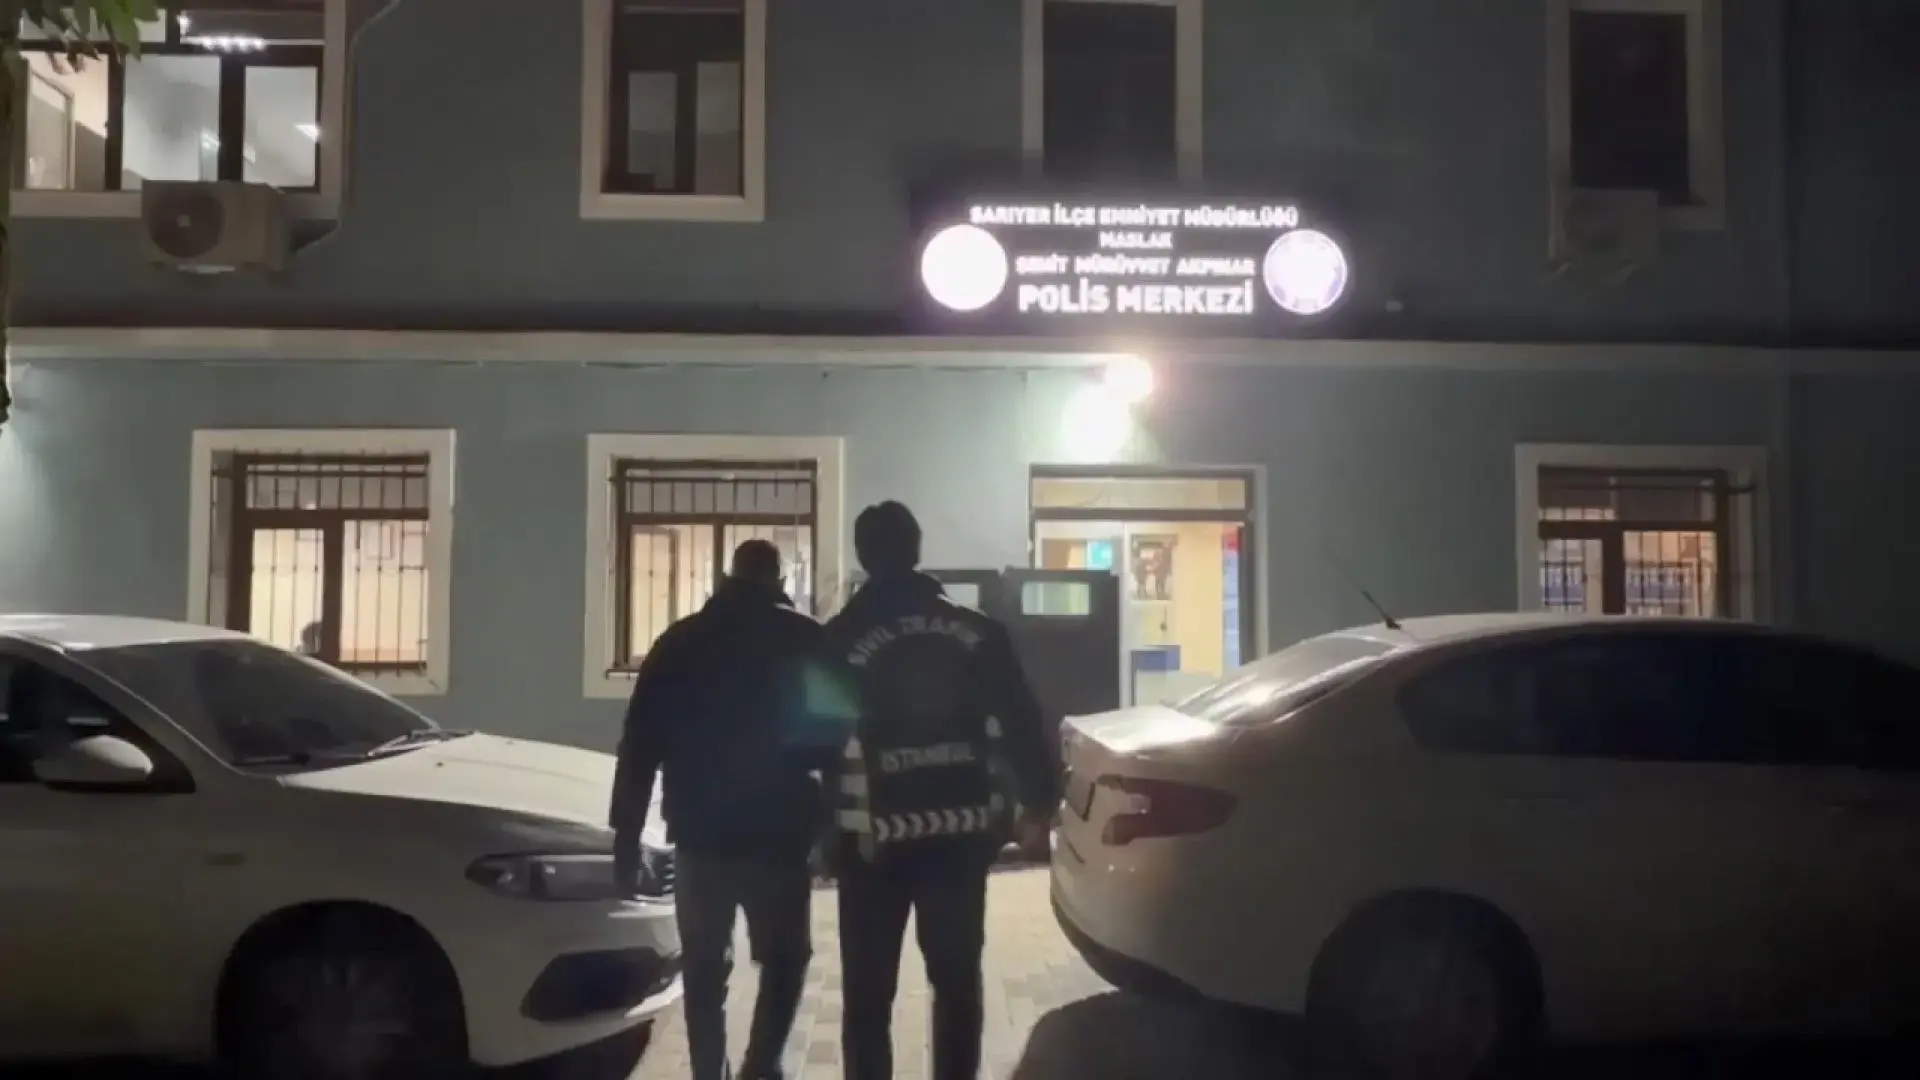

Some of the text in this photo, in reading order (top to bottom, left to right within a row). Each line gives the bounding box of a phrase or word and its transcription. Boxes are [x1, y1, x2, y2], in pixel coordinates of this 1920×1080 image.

[969, 205, 1051, 226] SARIYER
[1054, 202, 1096, 228] İLÇE
[1018, 278, 1254, 313] POLİS MERKEZİ
